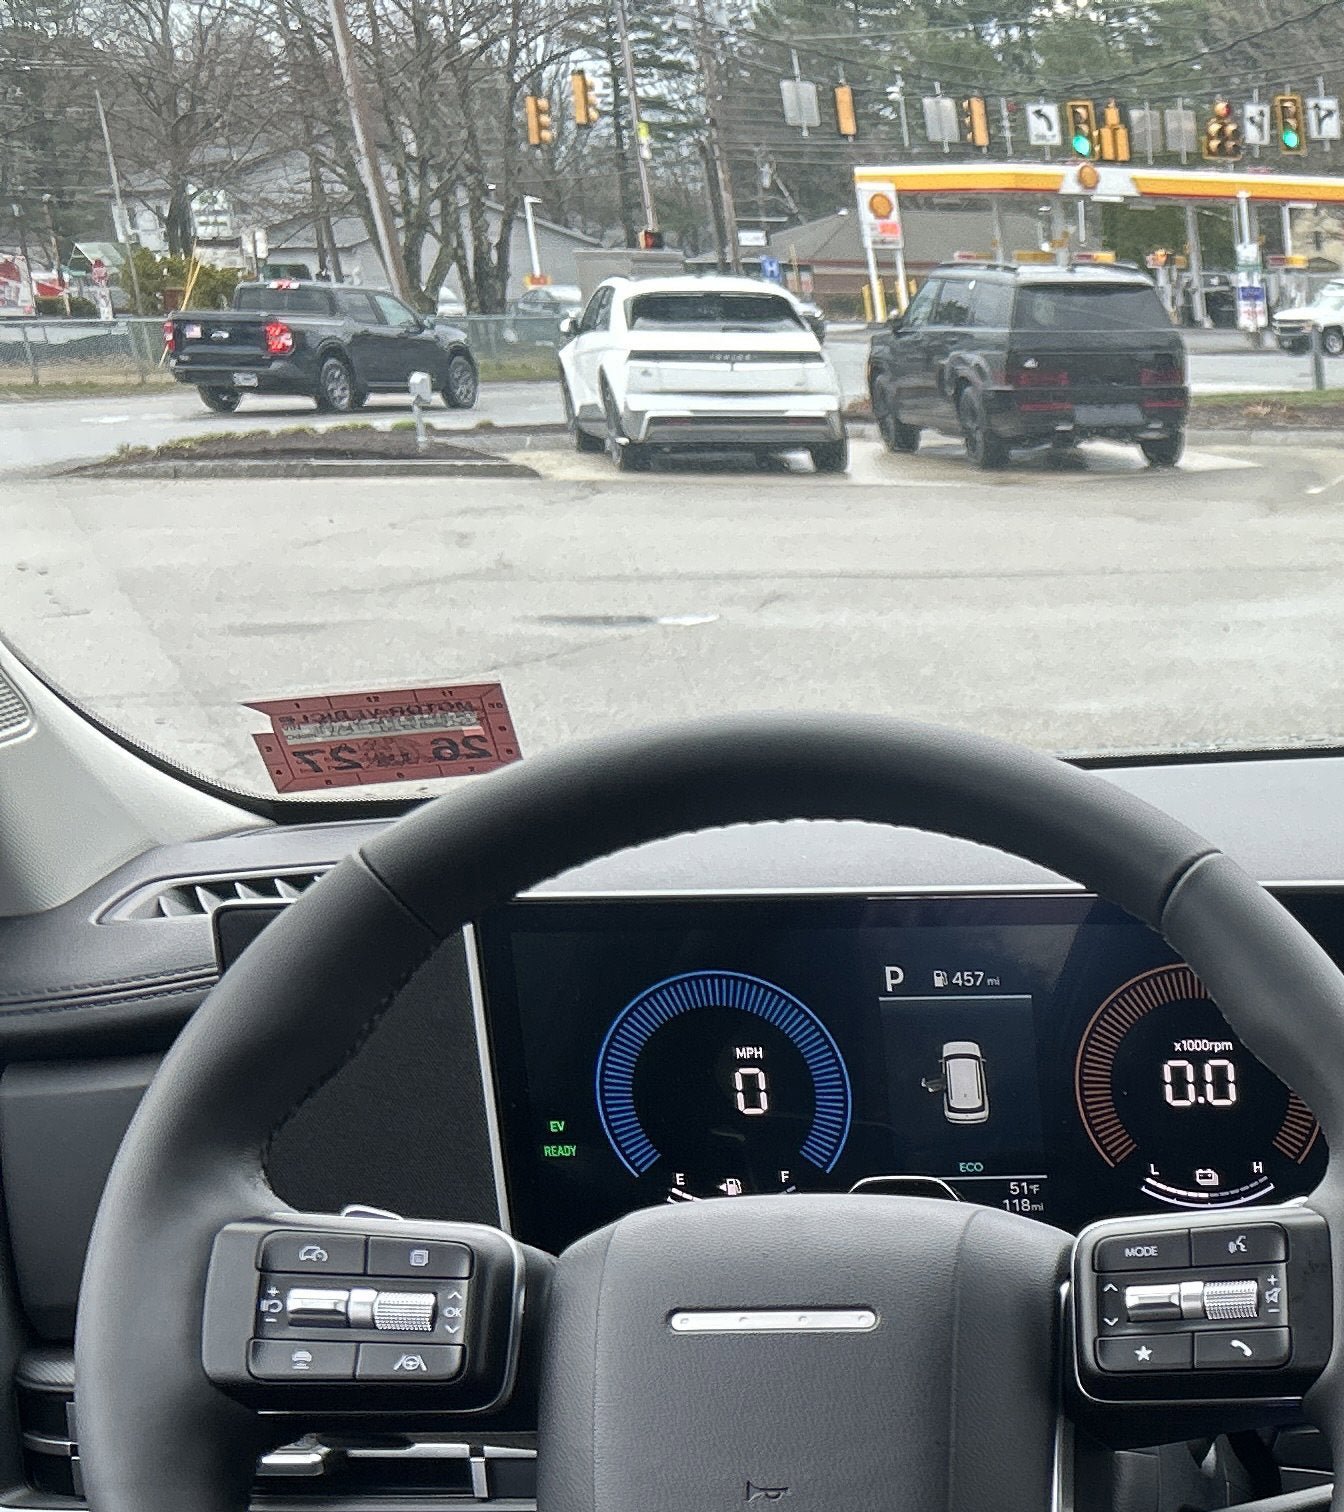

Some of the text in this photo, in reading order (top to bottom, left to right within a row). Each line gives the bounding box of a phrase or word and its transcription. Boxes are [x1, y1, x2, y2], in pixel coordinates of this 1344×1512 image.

[885, 966, 904, 992] P
[952, 972, 985, 986] 457
[736, 1046, 763, 1059] MPH
[1174, 1039, 1233, 1053] x1000rpm
[1163, 1059, 1237, 1106] 0.0
[735, 1067, 768, 1114] 0
[550, 1121, 565, 1132] EV
[544, 1145, 577, 1157] READY
[960, 1162, 984, 1172] ECO
[1150, 1163, 1160, 1176] L
[1253, 1161, 1263, 1174] H
[676, 1173, 685, 1185] E
[781, 1171, 789, 1183] F
[1125, 1246, 1158, 1258] MODE
[443, 1307, 463, 1319] OK
